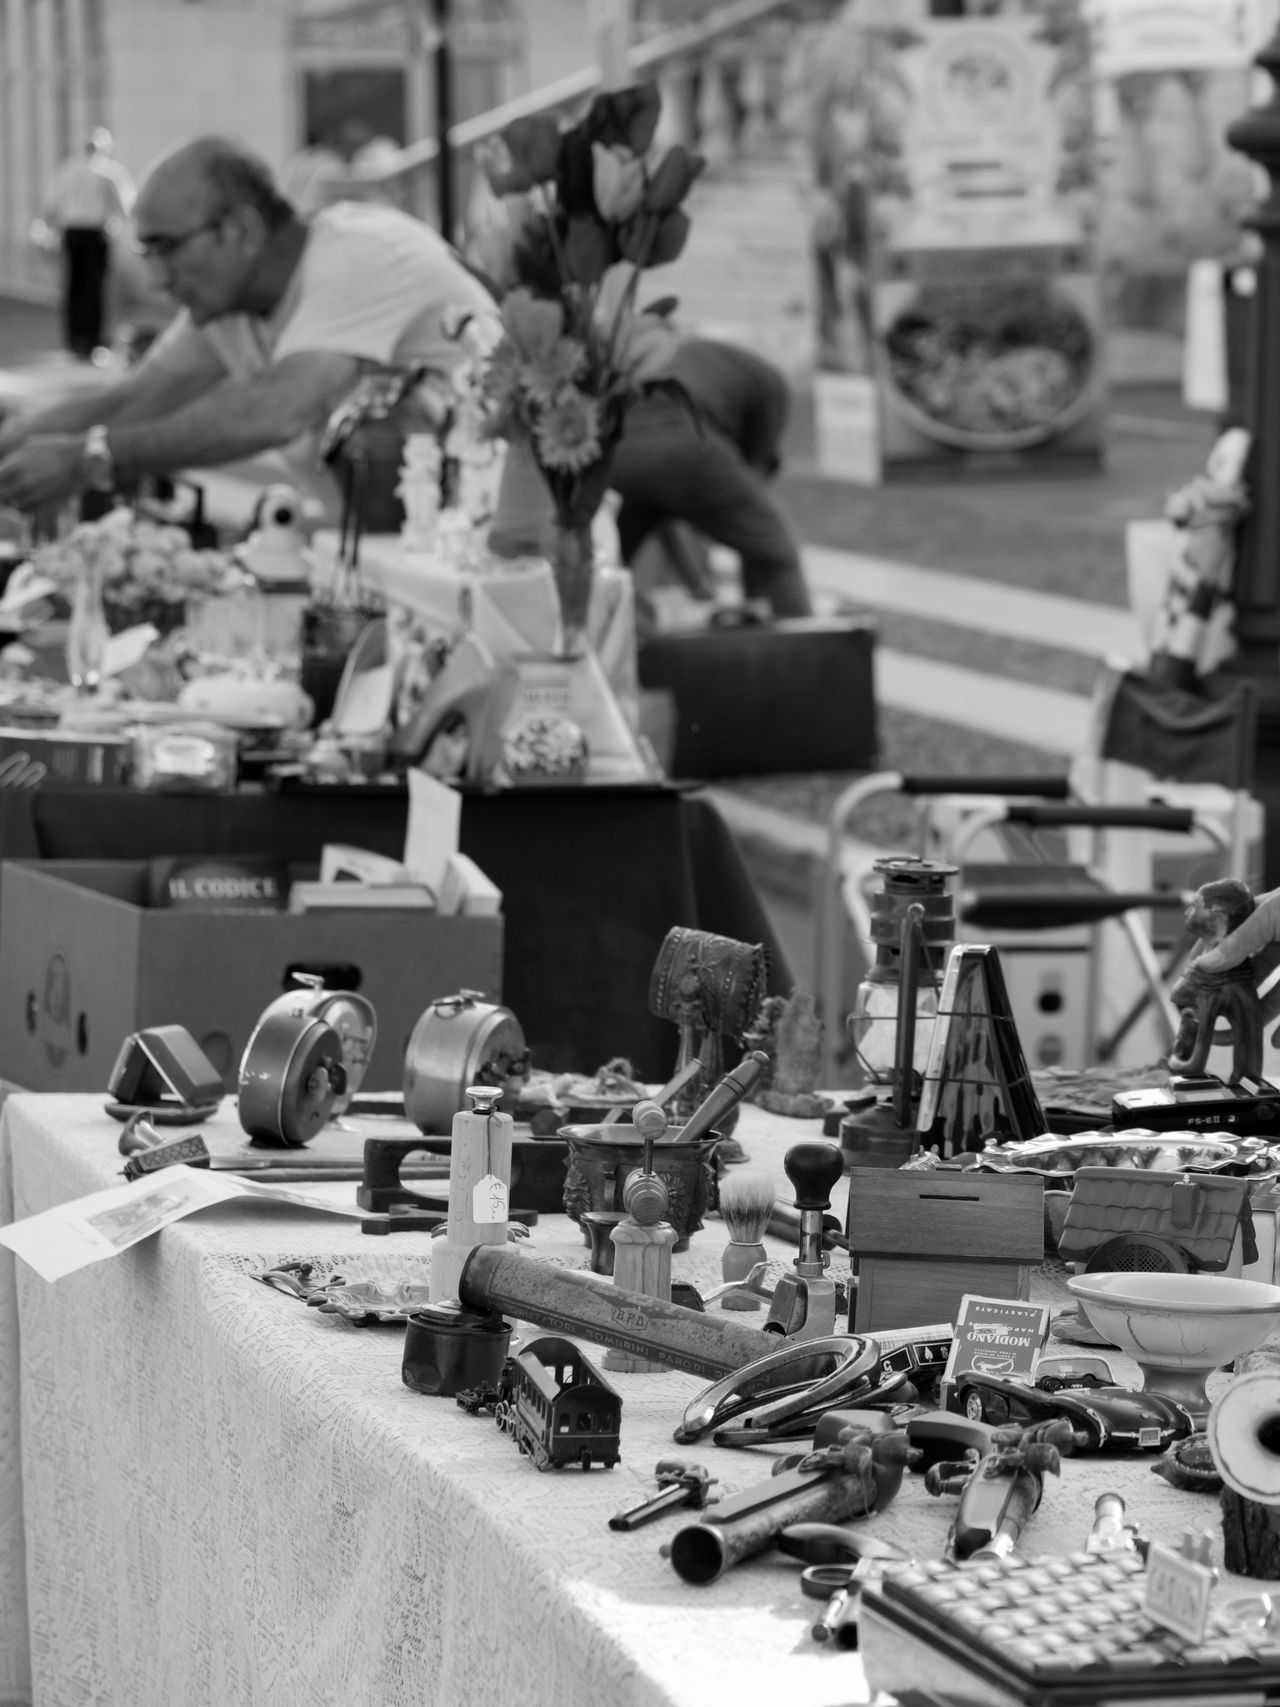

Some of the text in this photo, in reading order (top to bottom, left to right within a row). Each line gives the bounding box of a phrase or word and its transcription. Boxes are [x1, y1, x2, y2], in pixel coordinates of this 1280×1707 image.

[168, 877, 279, 899] IL CODICE
[975, 1306, 1037, 1318] PLASTICATE
[967, 1331, 1032, 1348] MODIANO
